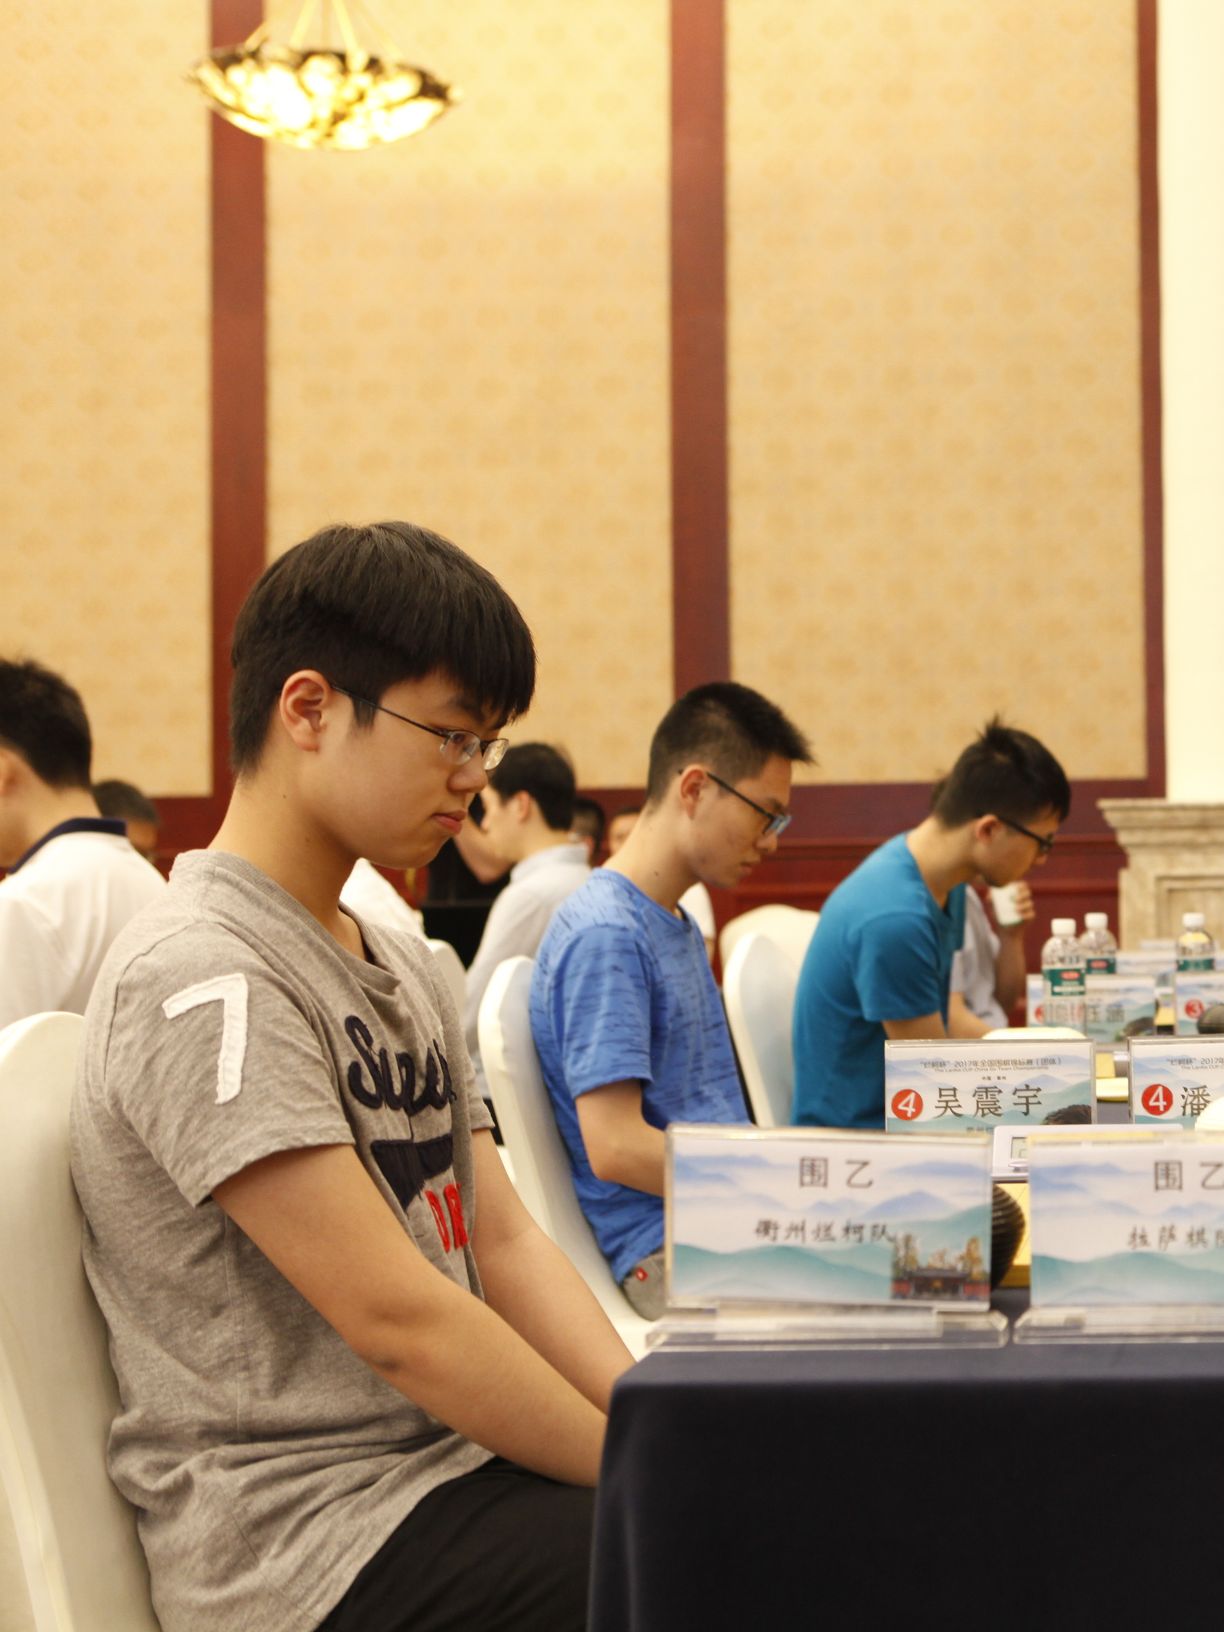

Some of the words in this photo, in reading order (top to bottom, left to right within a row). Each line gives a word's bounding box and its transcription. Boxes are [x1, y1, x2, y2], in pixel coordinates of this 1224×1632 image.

[162, 973, 248, 1104] 7
[935, 1084, 1042, 1118] 吴震宇
